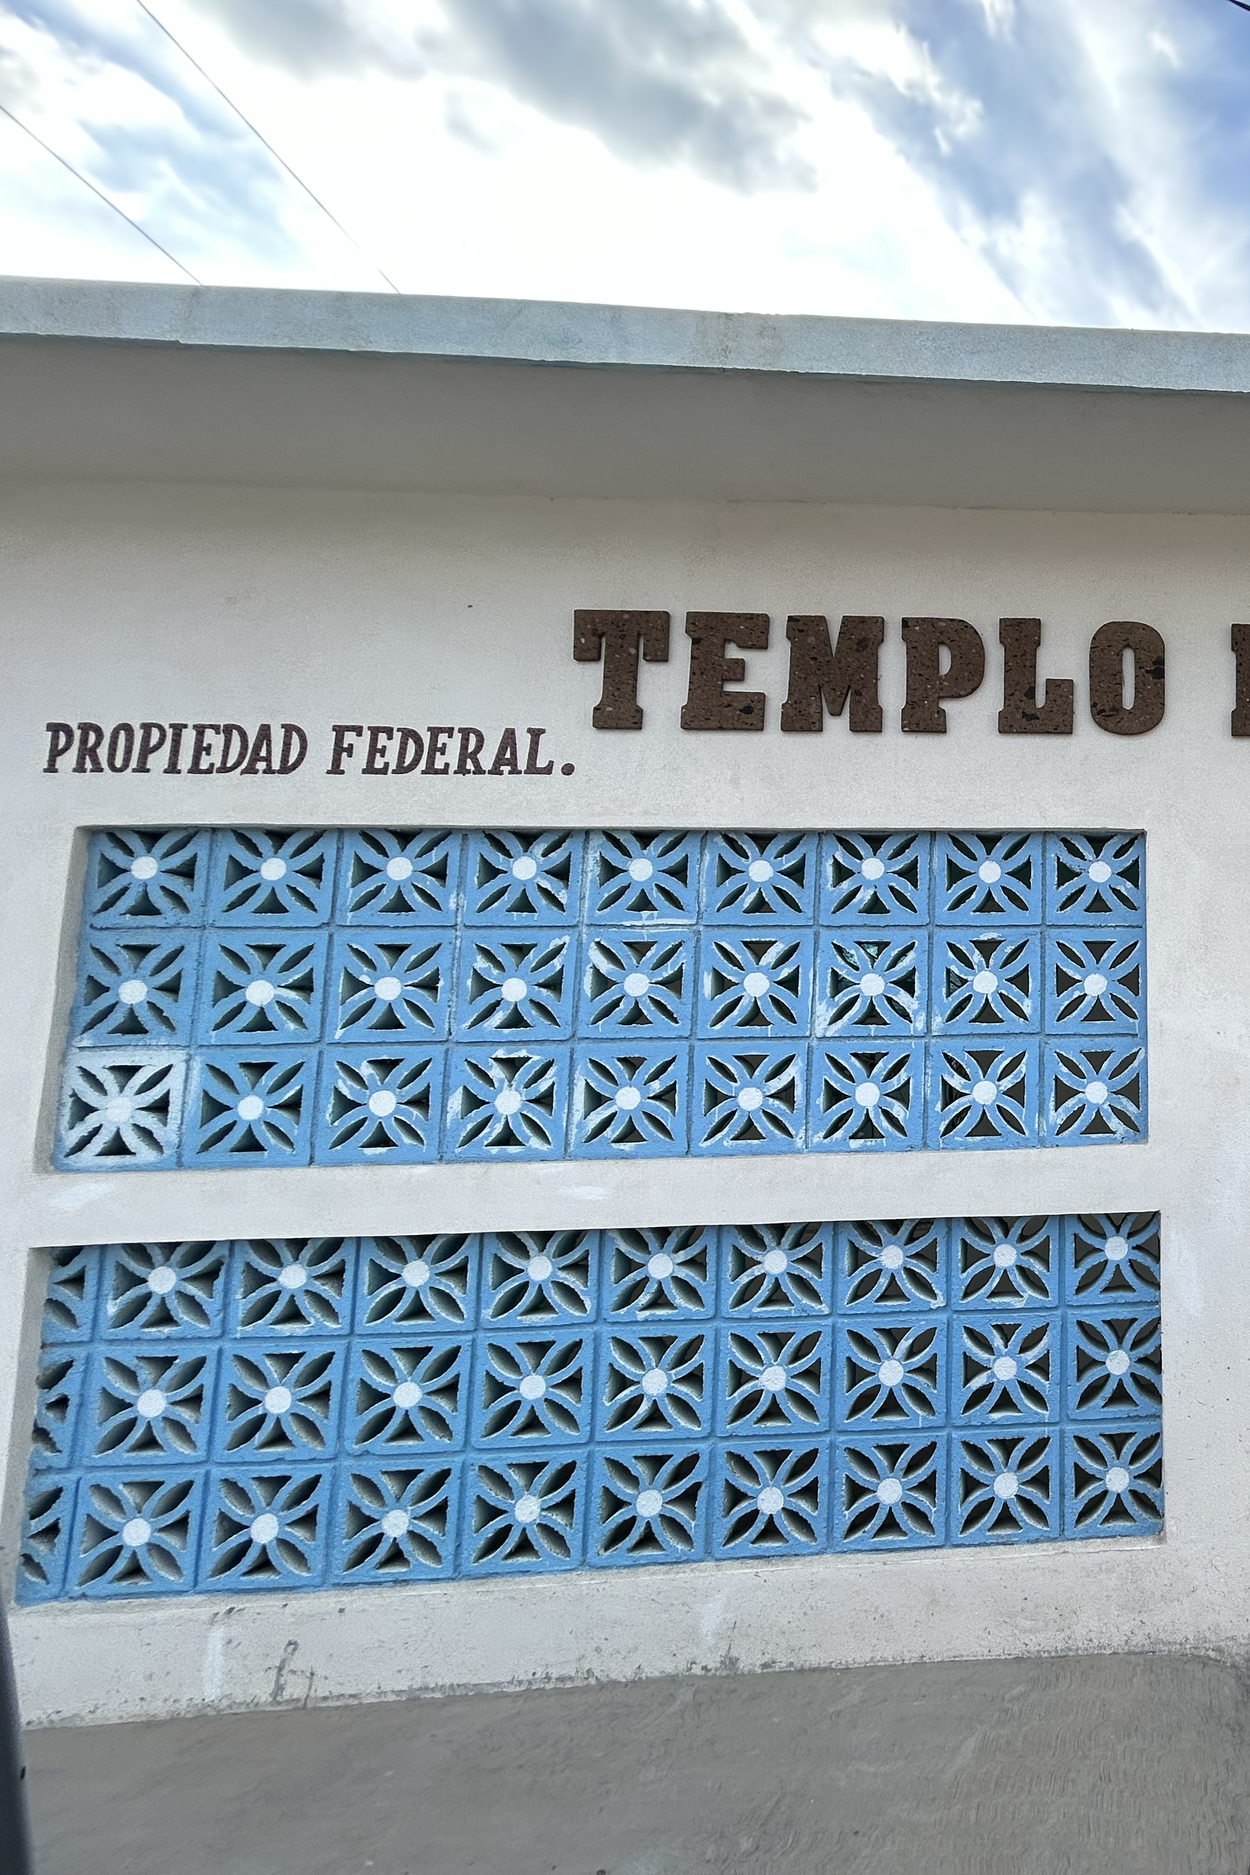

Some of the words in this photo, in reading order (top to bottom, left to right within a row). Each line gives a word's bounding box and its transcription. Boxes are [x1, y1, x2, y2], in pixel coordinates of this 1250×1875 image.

[573, 609, 1166, 737] TEMPLO
[43, 722, 308, 776] PROPIEDAD
[325, 724, 575, 777] FEDERAL.
